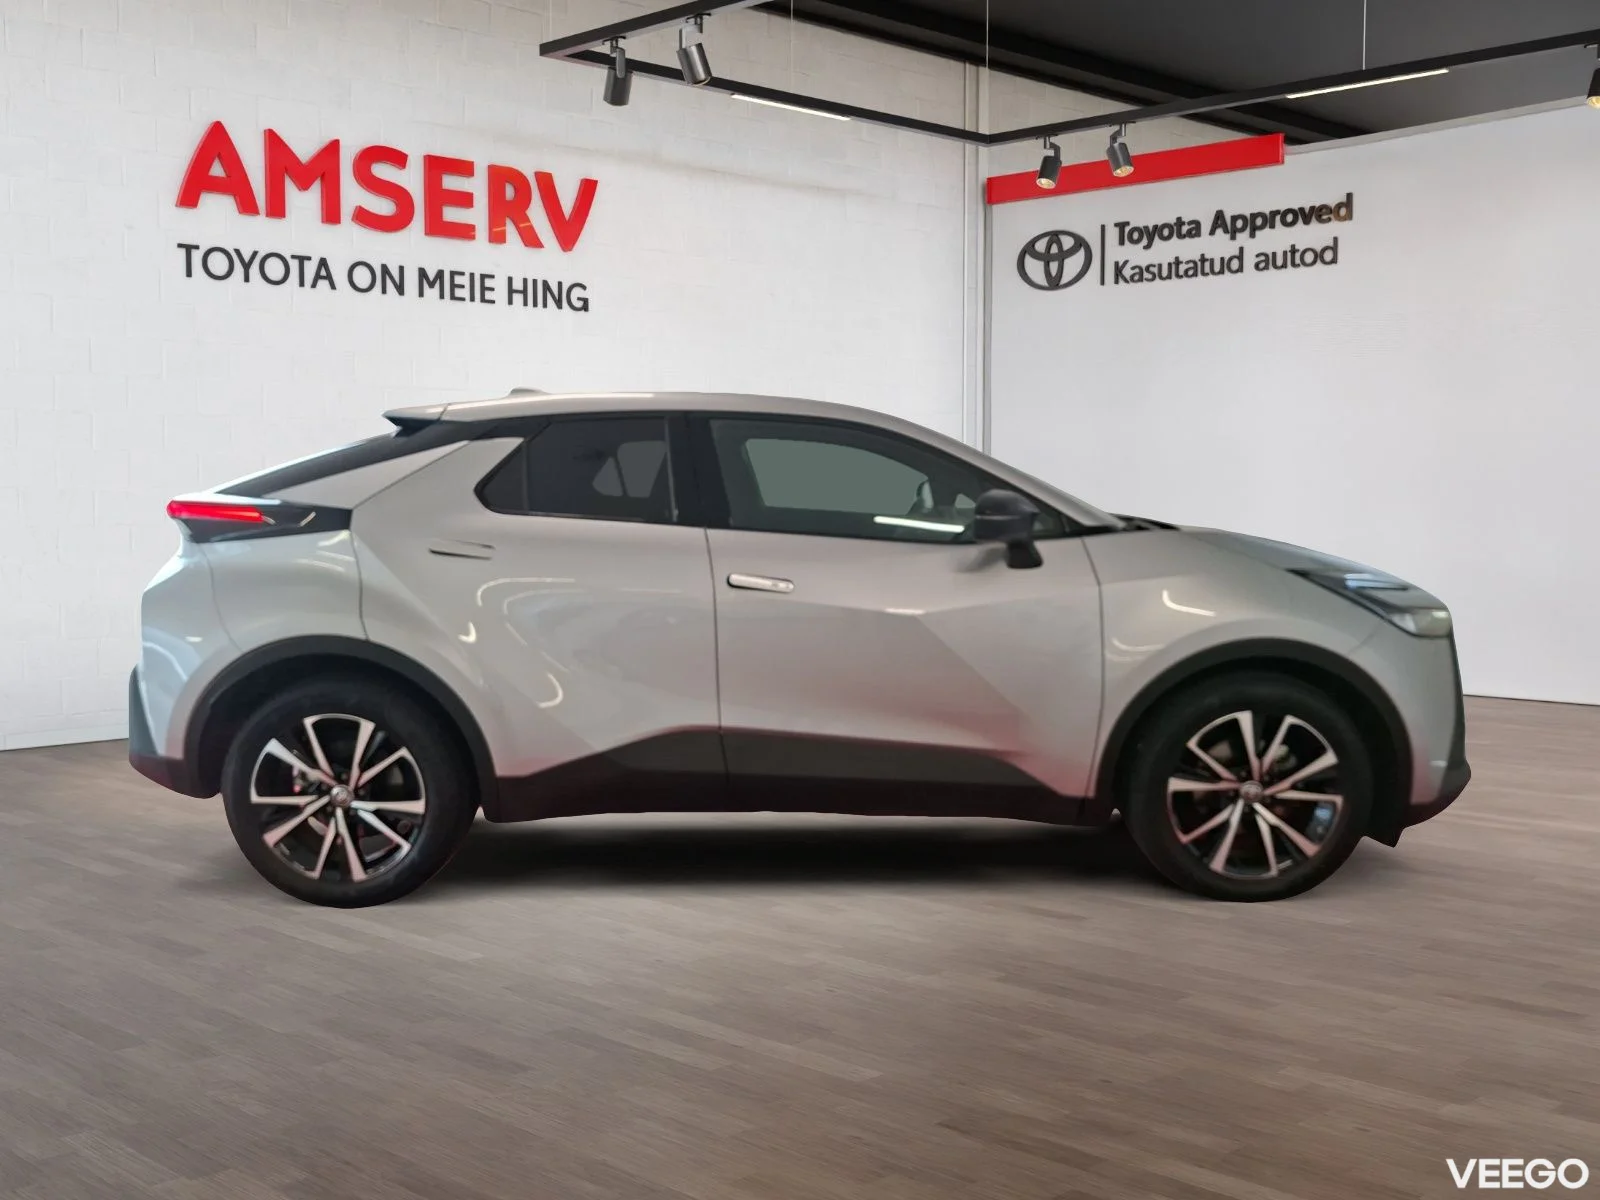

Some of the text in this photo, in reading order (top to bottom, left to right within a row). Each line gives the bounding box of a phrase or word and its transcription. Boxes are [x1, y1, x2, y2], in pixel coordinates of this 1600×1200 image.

[175, 120, 598, 252] AMSERV
[1113, 192, 1354, 250] Toyota Approved
[176, 242, 590, 312] TOYOTA ON MEIE HING
[1113, 236, 1338, 285] Kasutatud autod
